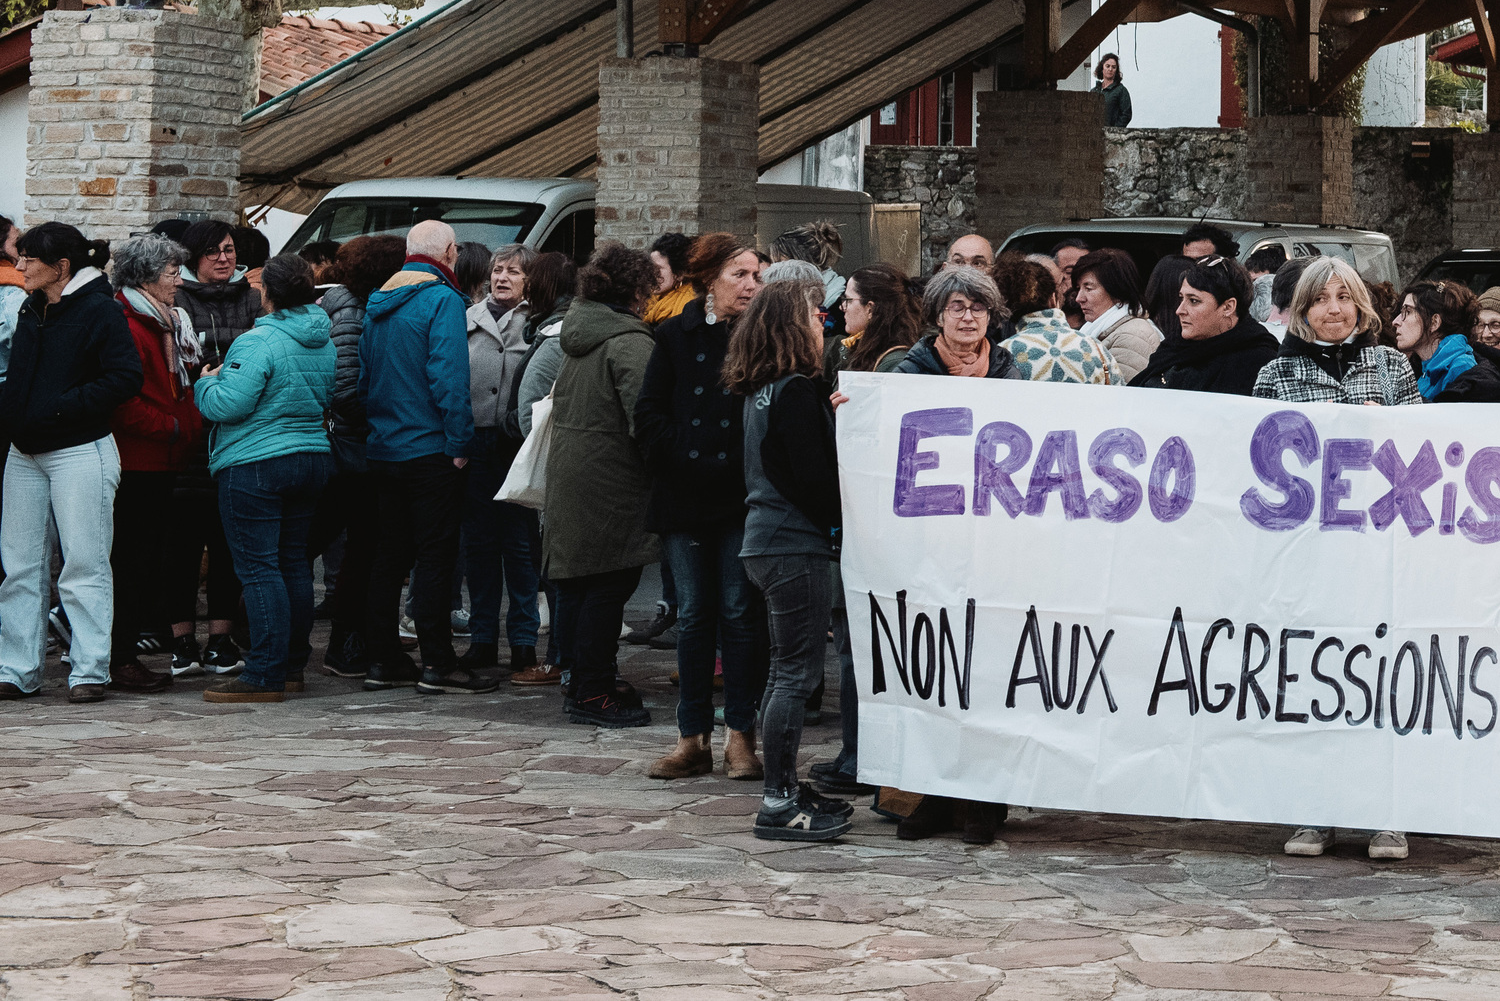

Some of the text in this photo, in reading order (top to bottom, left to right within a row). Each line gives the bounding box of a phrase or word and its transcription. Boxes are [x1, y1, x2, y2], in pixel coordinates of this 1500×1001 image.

[892, 405, 1195, 524] ERASO
[868, 589, 976, 710] NON
[1005, 604, 1118, 715] AUX
